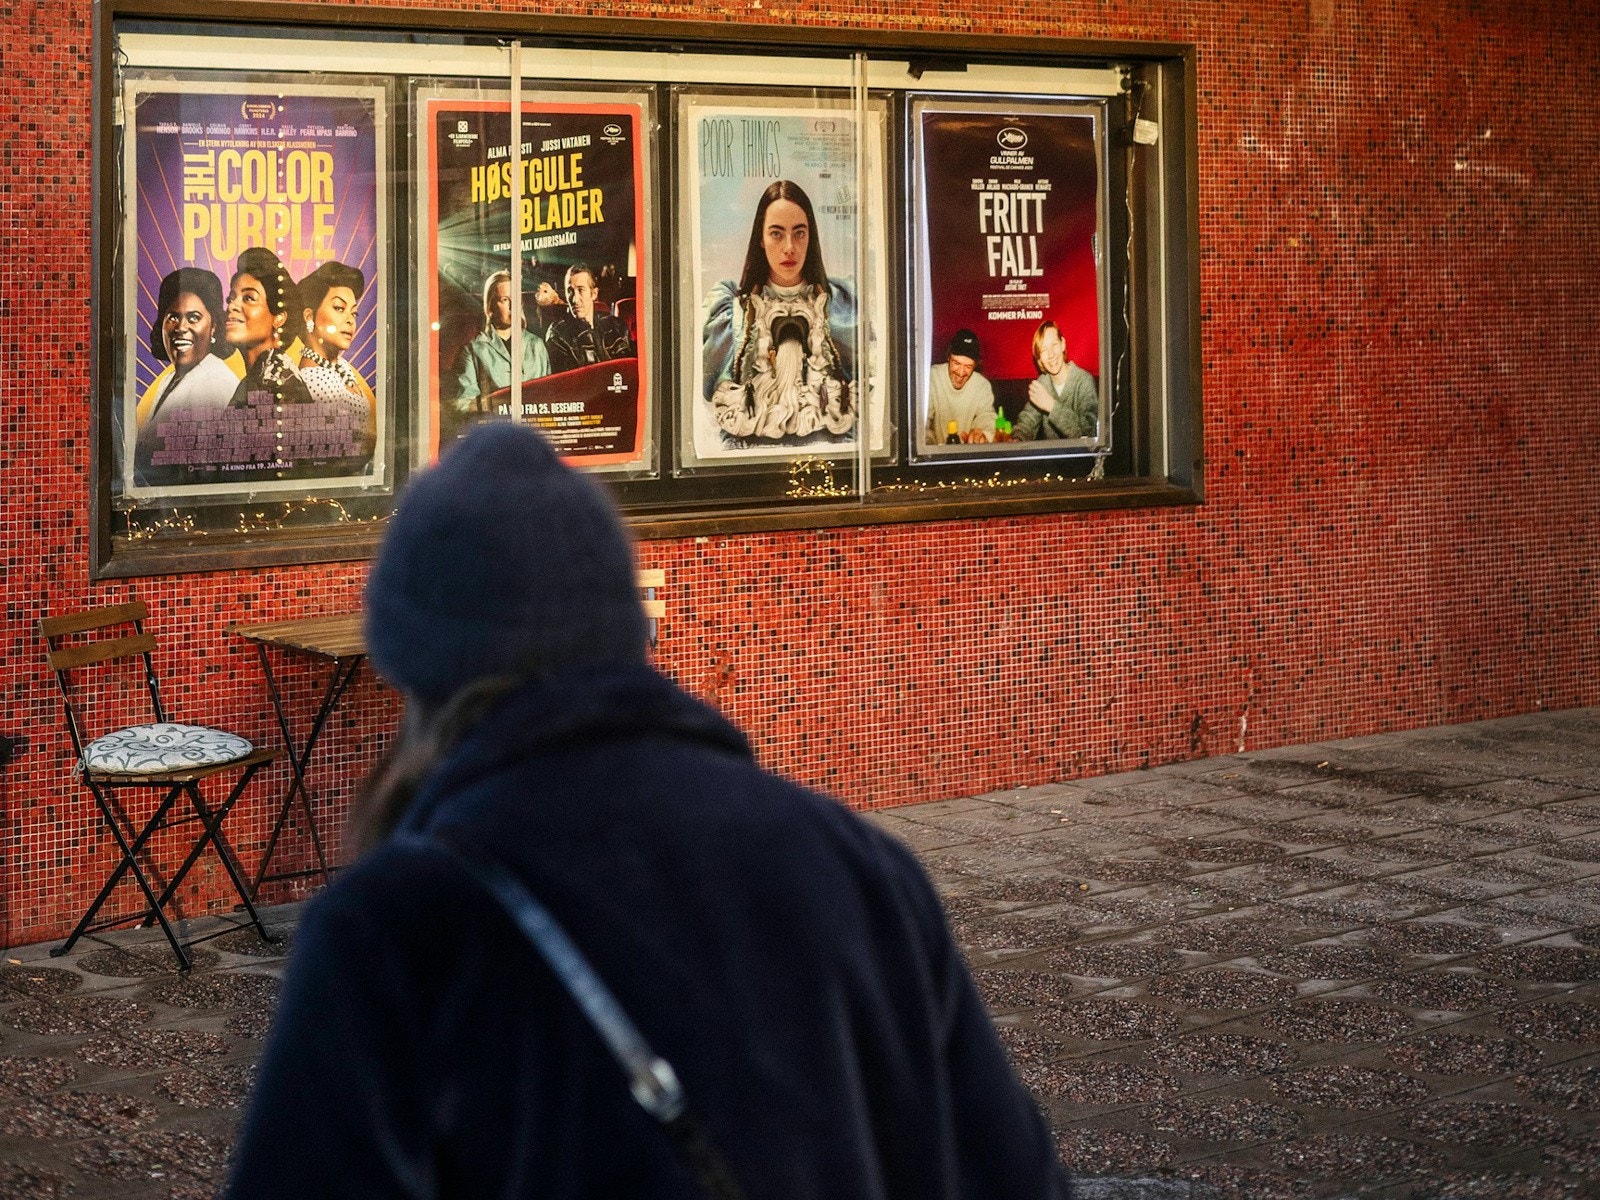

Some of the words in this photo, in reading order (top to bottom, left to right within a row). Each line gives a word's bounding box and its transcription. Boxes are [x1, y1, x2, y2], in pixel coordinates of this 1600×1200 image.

[487, 145, 507, 159] ALMA
[508, 143, 532, 156] PSTI
[541, 138, 561, 152] JUSSI
[561, 135, 591, 149] VATANEN
[702, 119, 734, 177] POOR
[741, 119, 781, 178] THINGS
[990, 156, 1034, 165] GULLPALMEN
[183, 150, 215, 201] THE
[218, 150, 335, 204] COLOR
[471, 153, 584, 204] HØSTGULE
[183, 203, 336, 262] PURPLE
[521, 188, 605, 235] BLADER
[979, 192, 1047, 234] FRITT
[521, 239, 533, 252] AKI
[533, 232, 577, 250] KAURISMÄKI
[987, 235, 1044, 277] FALL
[988, 311, 1016, 320] KOMMER
[1016, 308, 1026, 319] PÅ
[1026, 310, 1043, 320] KINO
[498, 404, 508, 416] PÅ
[525, 403, 539, 415] FRA
[539, 403, 551, 414] 25.
[551, 402, 585, 414] DESEMBER
[230, 463, 245, 471] KINO
[267, 461, 293, 469] JANUAR
